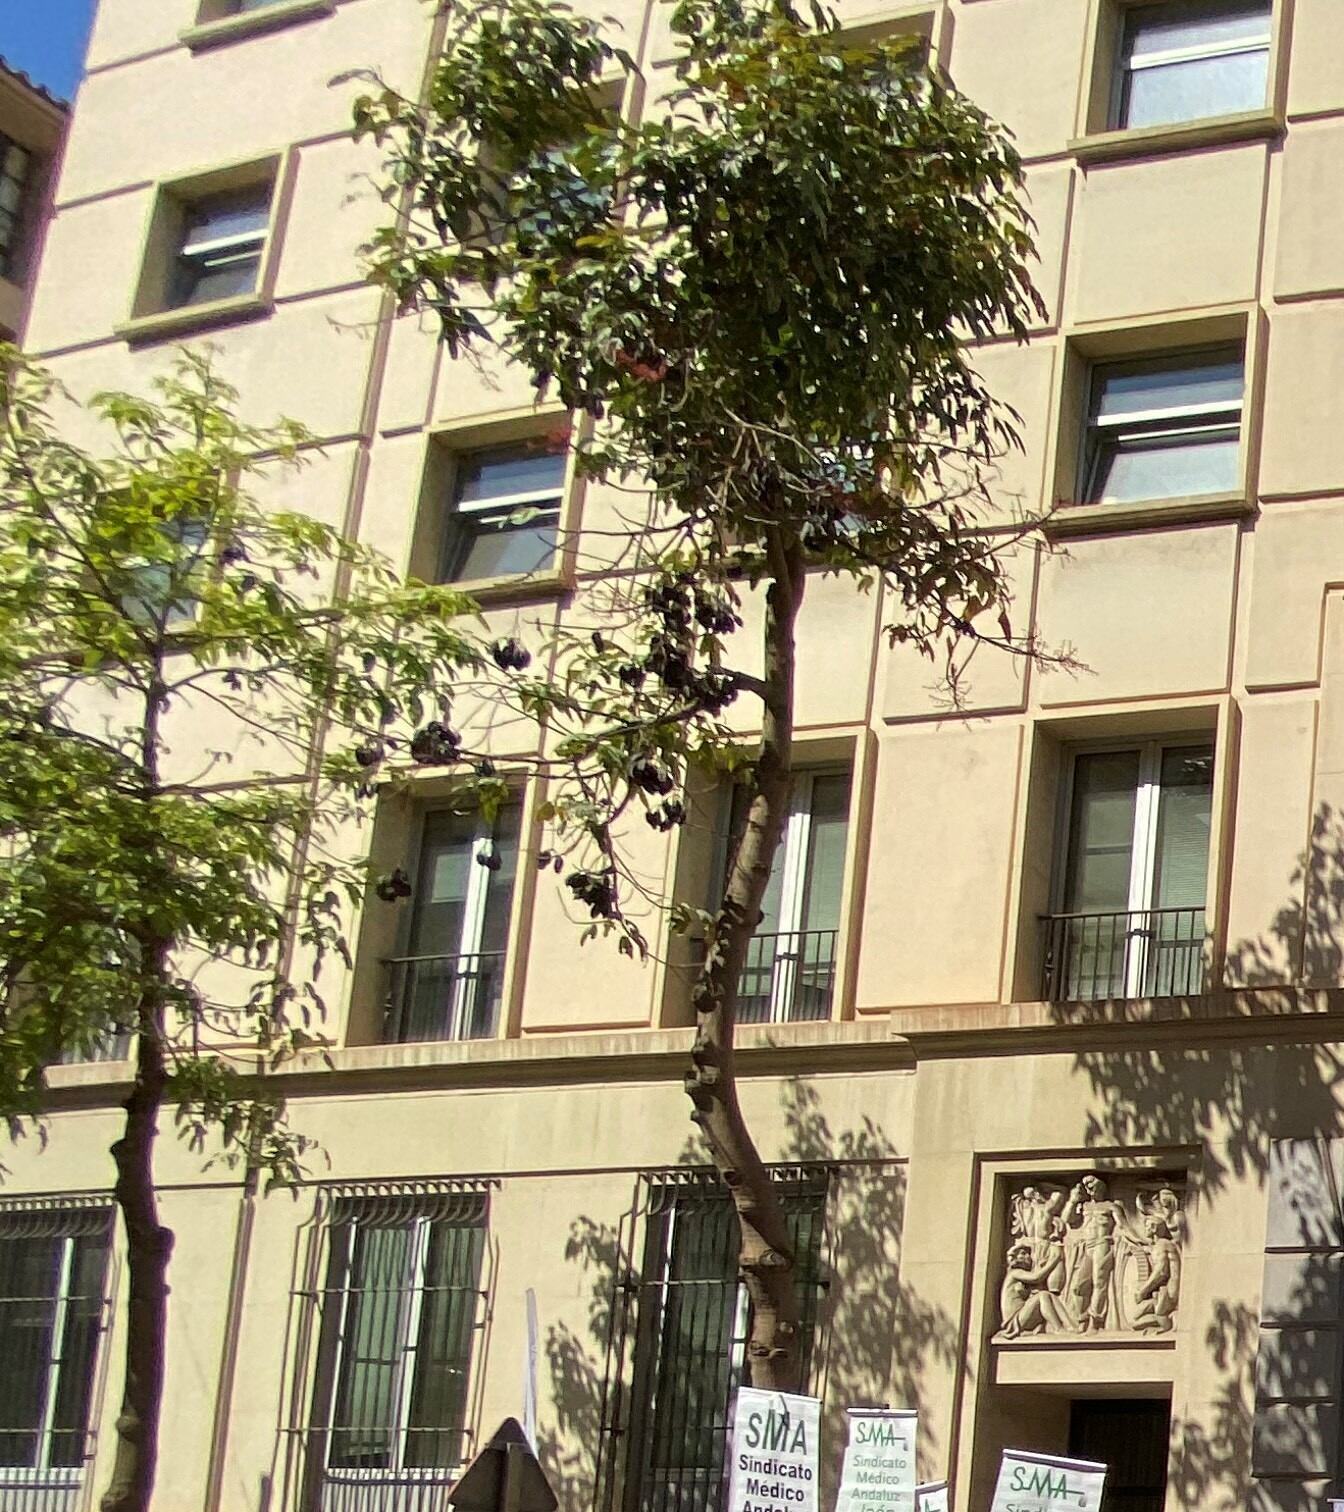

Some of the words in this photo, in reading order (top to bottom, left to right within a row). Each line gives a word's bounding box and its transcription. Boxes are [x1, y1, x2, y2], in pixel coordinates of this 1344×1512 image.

[745, 1408, 808, 1455] SMA
[855, 1422, 906, 1447] SMA
[738, 1454, 813, 1482] Sindicato
[853, 1453, 907, 1470] Sindicato
[746, 1478, 804, 1503] Médico
[856, 1471, 900, 1486] Médico
[1010, 1467, 1085, 1501] SMA
[851, 1488, 901, 1502] Andaluz
